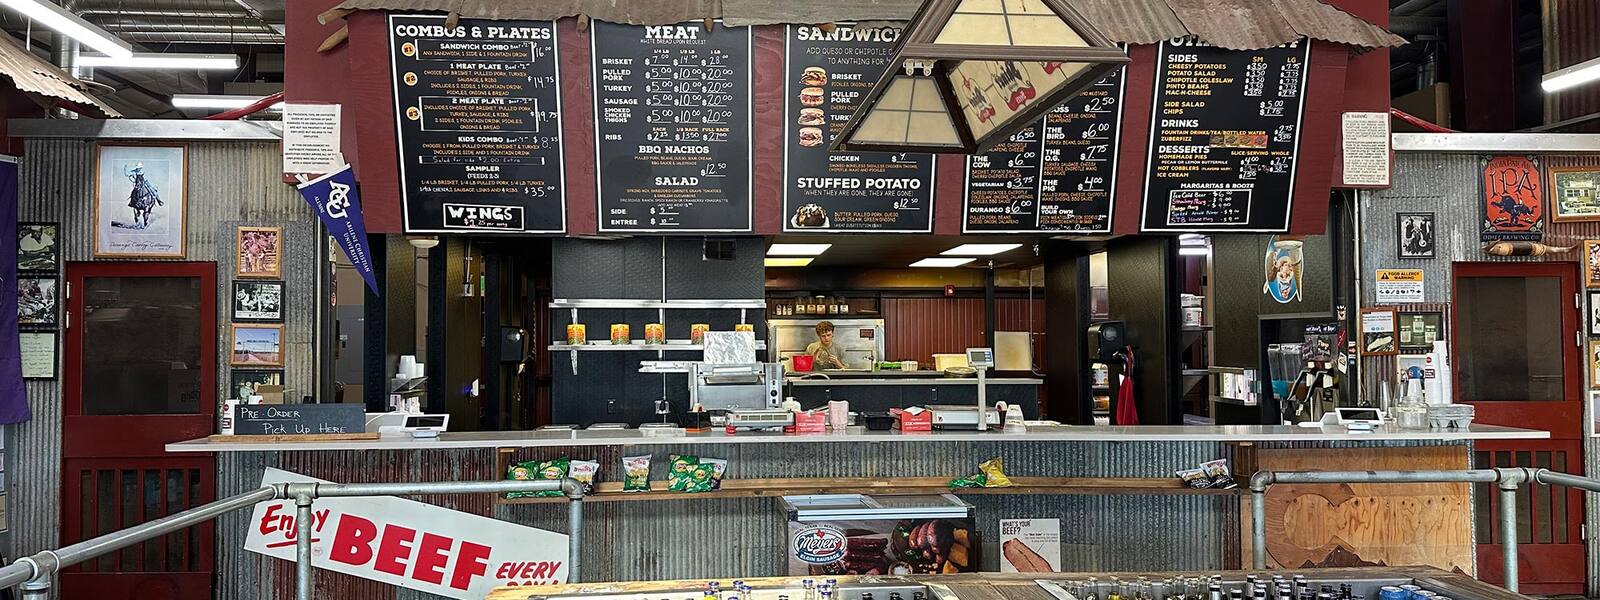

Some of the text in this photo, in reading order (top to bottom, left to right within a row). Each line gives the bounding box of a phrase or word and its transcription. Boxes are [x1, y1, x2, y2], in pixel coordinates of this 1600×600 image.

[396, 25, 551, 39] COMBOS & PLATES
[645, 26, 699, 39] MEAT
[1161, 119, 1199, 127] DRINKS
[665, 146, 709, 154] NACHOS
[655, 177, 698, 185] SALAD
[798, 178, 920, 189] STUFFED POTATO
[1490, 168, 1537, 200] IPA
[448, 207, 512, 220] WINGS
[1002, 527, 1021, 535] BEEF?
[329, 514, 491, 591] BEEF
[496, 561, 561, 579] EVERY
[817, 553, 840, 561] SAUSAGE
